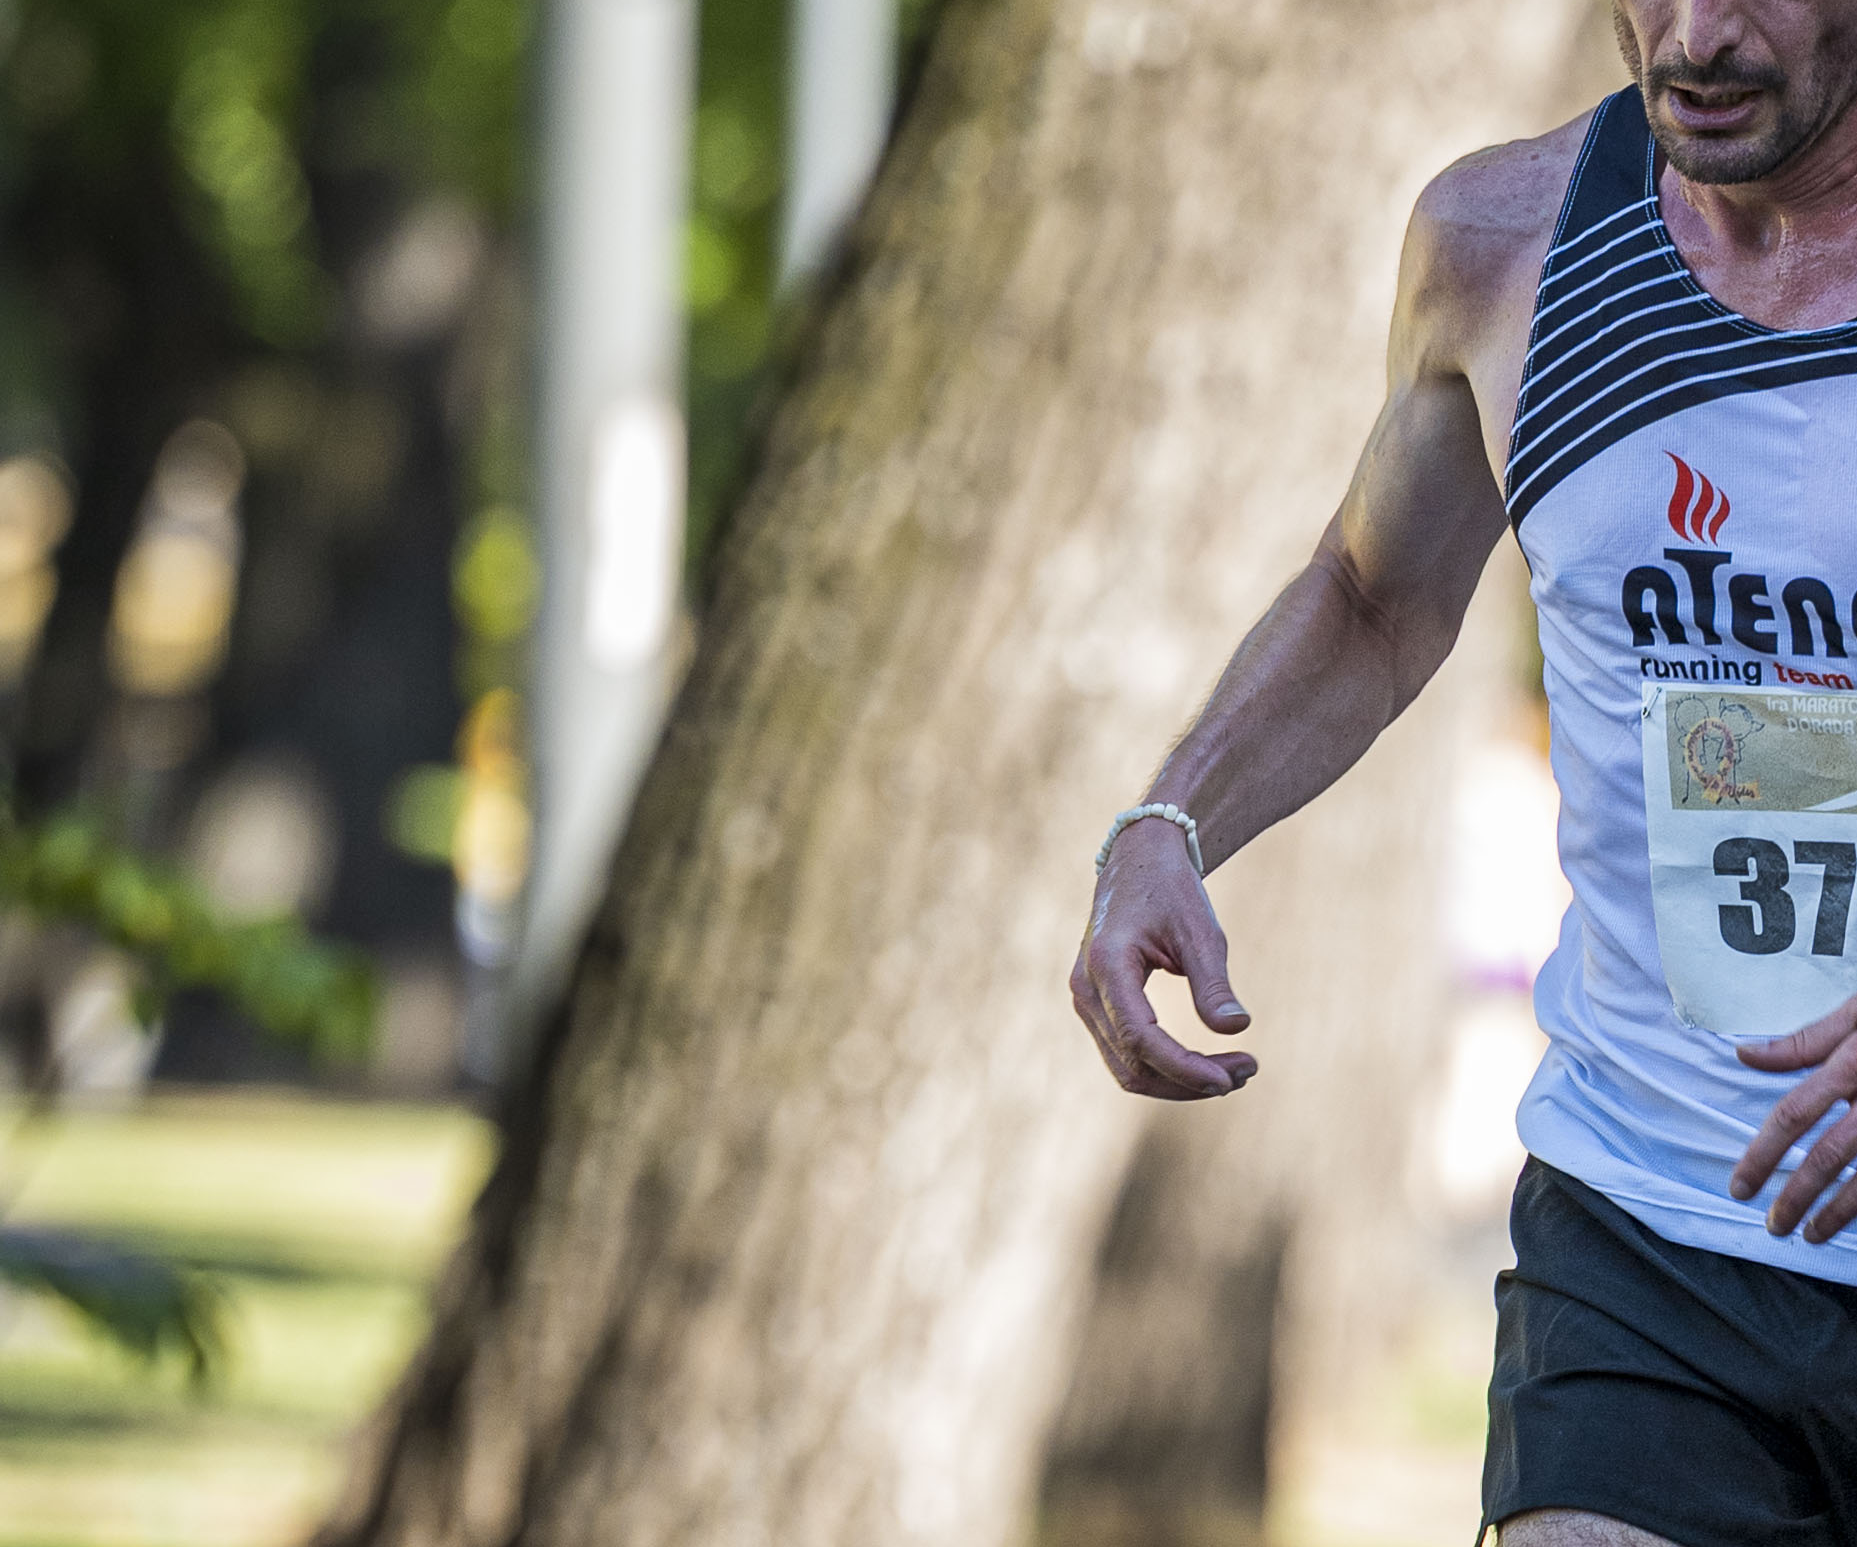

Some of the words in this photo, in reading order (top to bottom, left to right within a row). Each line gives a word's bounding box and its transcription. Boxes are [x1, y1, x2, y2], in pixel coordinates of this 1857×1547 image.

[1640, 654, 1763, 686] running
[1773, 661, 1854, 690] team
[1787, 716, 1856, 735] DORADA
